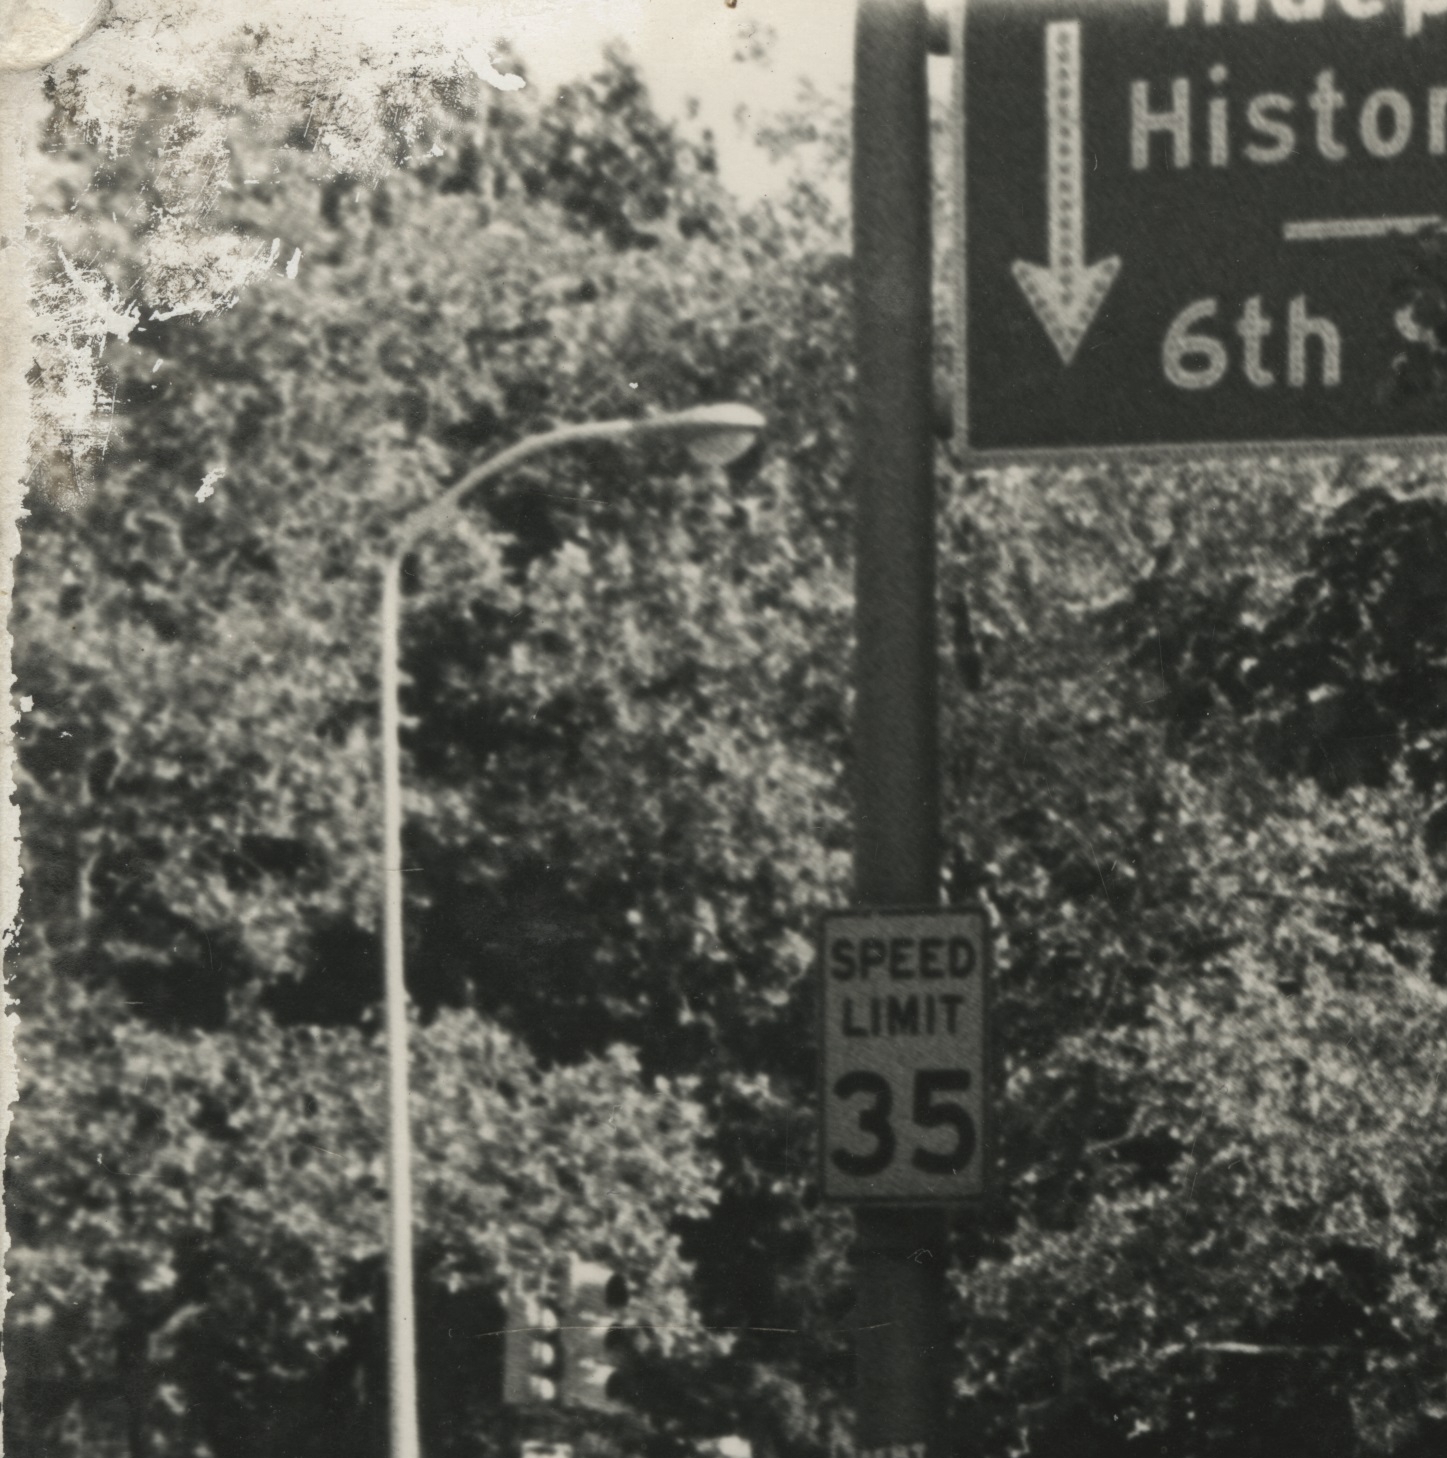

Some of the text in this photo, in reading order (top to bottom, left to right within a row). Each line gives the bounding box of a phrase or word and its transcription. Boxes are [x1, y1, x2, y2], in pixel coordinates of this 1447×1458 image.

[1161, 294, 1343, 389] 6th
[830, 936, 977, 982] SPEED
[841, 992, 965, 1038] LIMIT
[830, 1068, 977, 1178] 35
